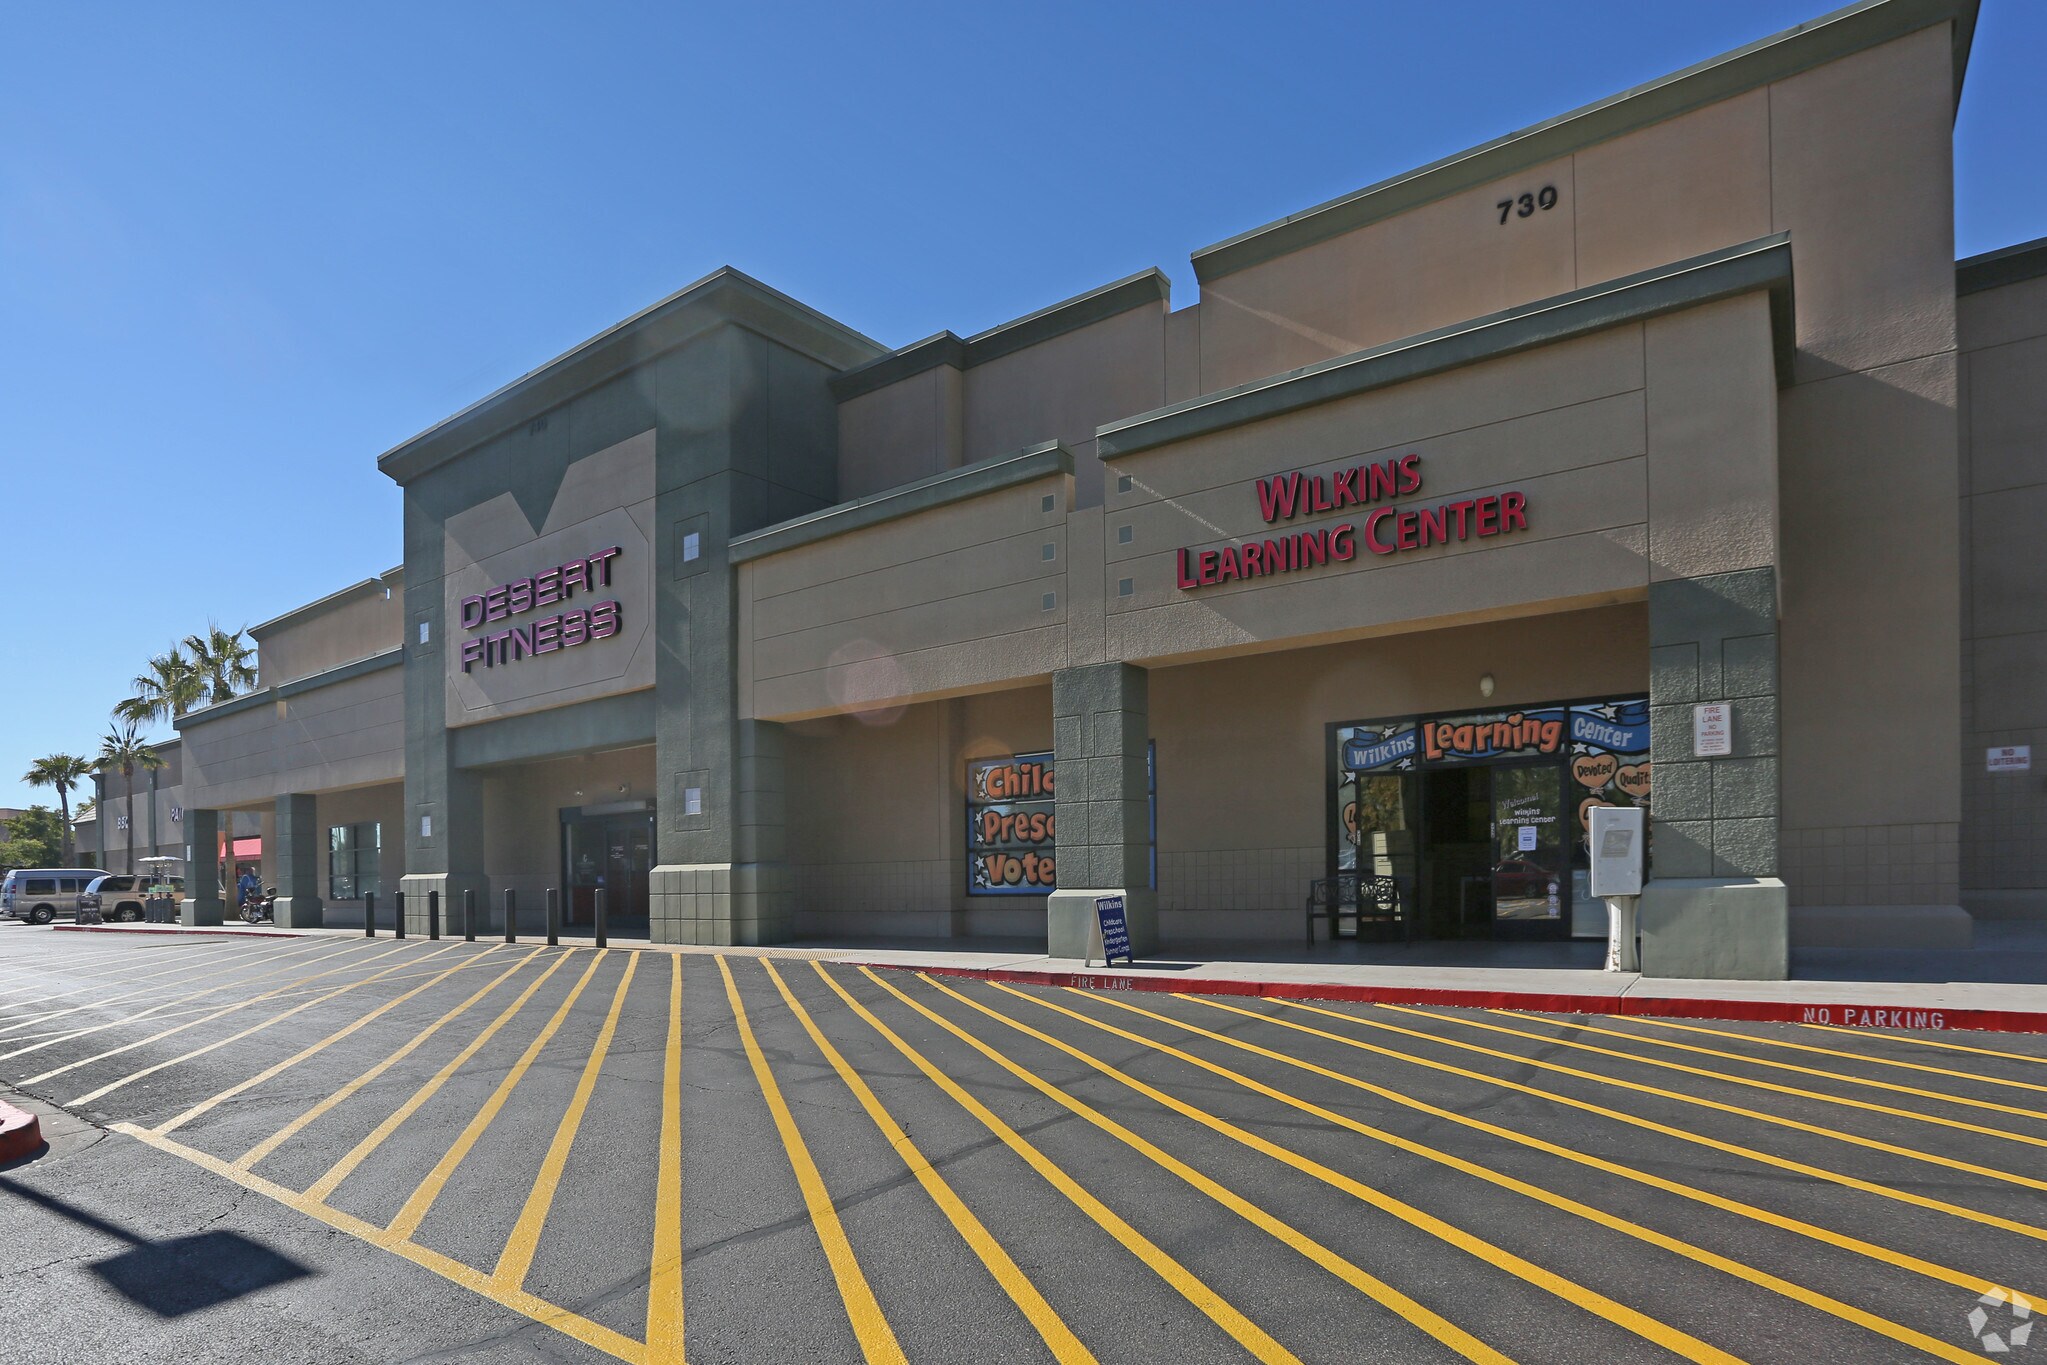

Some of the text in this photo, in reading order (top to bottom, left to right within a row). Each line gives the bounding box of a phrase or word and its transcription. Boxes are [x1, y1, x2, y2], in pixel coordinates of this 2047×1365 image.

[1497, 186, 1558, 225] 730
[461, 546, 621, 630] DESERT
[461, 600, 621, 674] FITNESS
[1704, 706, 1720, 714] FIRE
[1702, 715, 1722, 723] LANE
[1354, 712, 1633, 765] Wilkins Learning Center
[2001, 748, 2014, 756] NO
[1989, 757, 2028, 766] LOITERING
[1577, 762, 1613, 778] Devoted
[1620, 771, 1650, 788] Qualit
[1098, 900, 1122, 911] Wilkins
[1103, 918, 1123, 927] Childcare
[1104, 927, 1125, 936] Preschool
[1105, 936, 1128, 945] Kindergarten
[1071, 975, 1133, 991] FIRE LANE
[1803, 1007, 1945, 1030] NO PARKING
